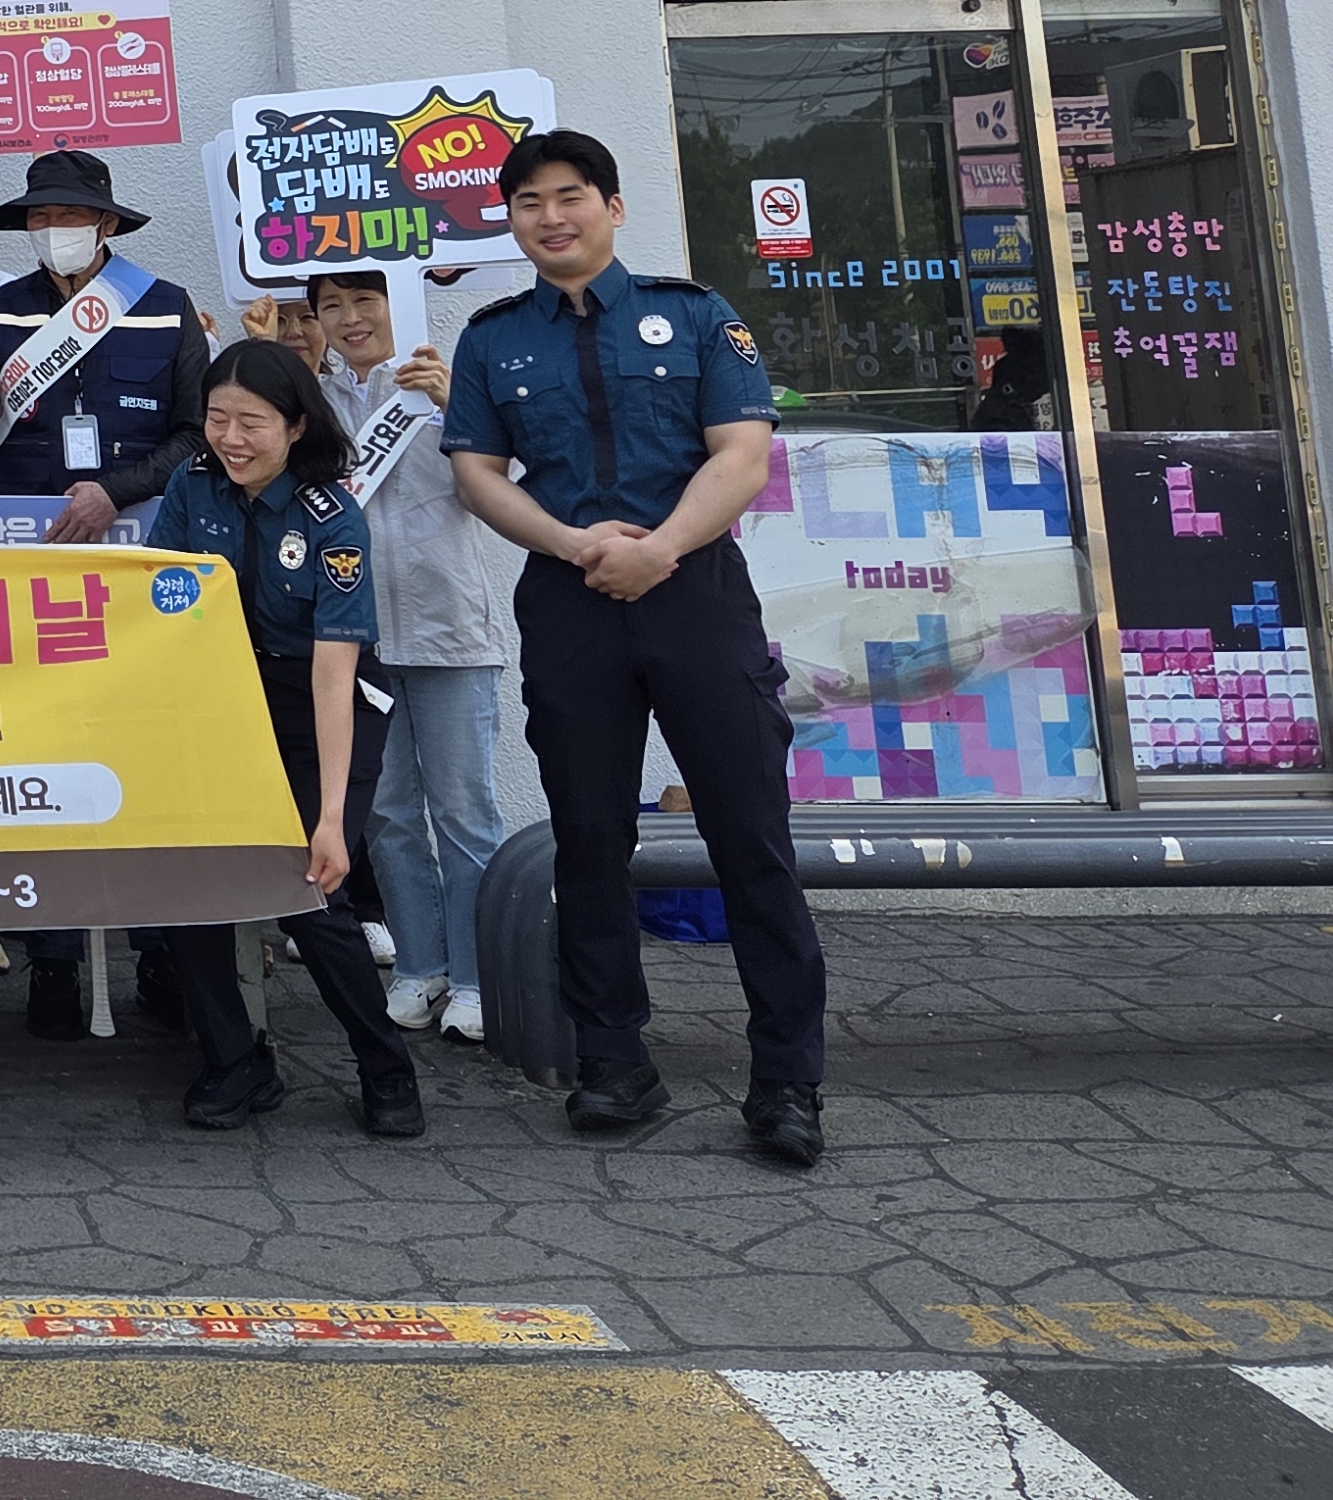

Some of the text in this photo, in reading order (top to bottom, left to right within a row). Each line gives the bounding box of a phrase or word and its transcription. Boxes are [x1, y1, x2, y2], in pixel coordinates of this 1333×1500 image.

[14, 4, 46, 16] 혈관을
[48, 1, 73, 13] 위해,
[33, 17, 84, 31] 확인해요!
[34, 68, 83, 83] 정상혈당
[250, 127, 397, 171] 전자담배도
[416, 123, 487, 170] NO!
[276, 163, 391, 215] 담배도
[260, 206, 430, 260] 하지마!
[1096, 212, 1225, 258] 감성충만
[880, 258, 963, 286] 2001
[1107, 270, 1233, 314] 잔돈탕진
[1113, 327, 1240, 380] 추억꿀잼
[118, 394, 158, 412] 금연지도원
[844, 560, 953, 594] today
[30, 572, 112, 666] 날
[159, 595, 191, 611] 거제
[13, 1301, 432, 1321] NO SMOKING AREA
